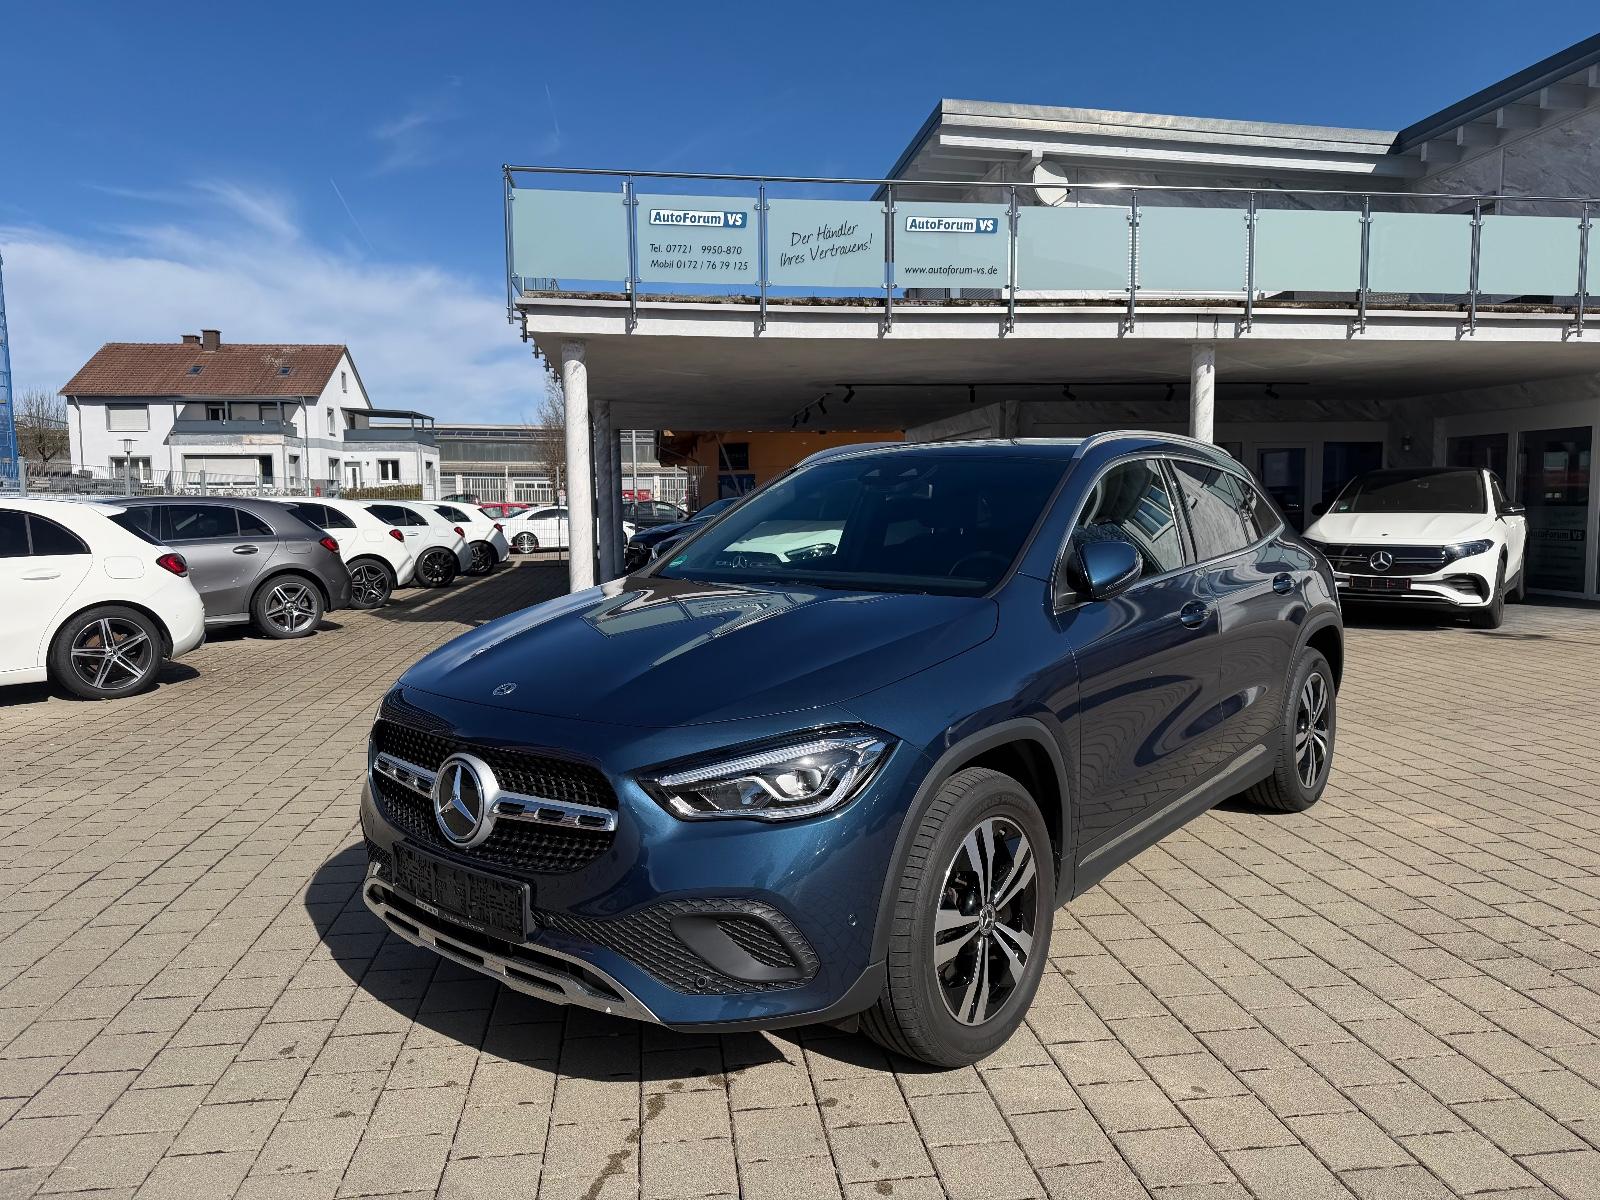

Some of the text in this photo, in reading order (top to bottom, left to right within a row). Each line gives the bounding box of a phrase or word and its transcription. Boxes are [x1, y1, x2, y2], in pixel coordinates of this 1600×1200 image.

[653, 211, 743, 226] AutoForum VS
[909, 218, 994, 232] AutoForum VS
[790, 220, 858, 247] Der Händler
[649, 243, 743, 255] Tel. 07721 9950-870
[780, 232, 873, 267] Ihres Vertrauens!
[650, 259, 674, 269] Mobil
[676, 260, 698, 269] 0172
[706, 260, 717, 270] 76
[719, 261, 730, 270] 79
[733, 261, 749, 271] 125
[904, 264, 998, 276] www.autoforum-vs.de
